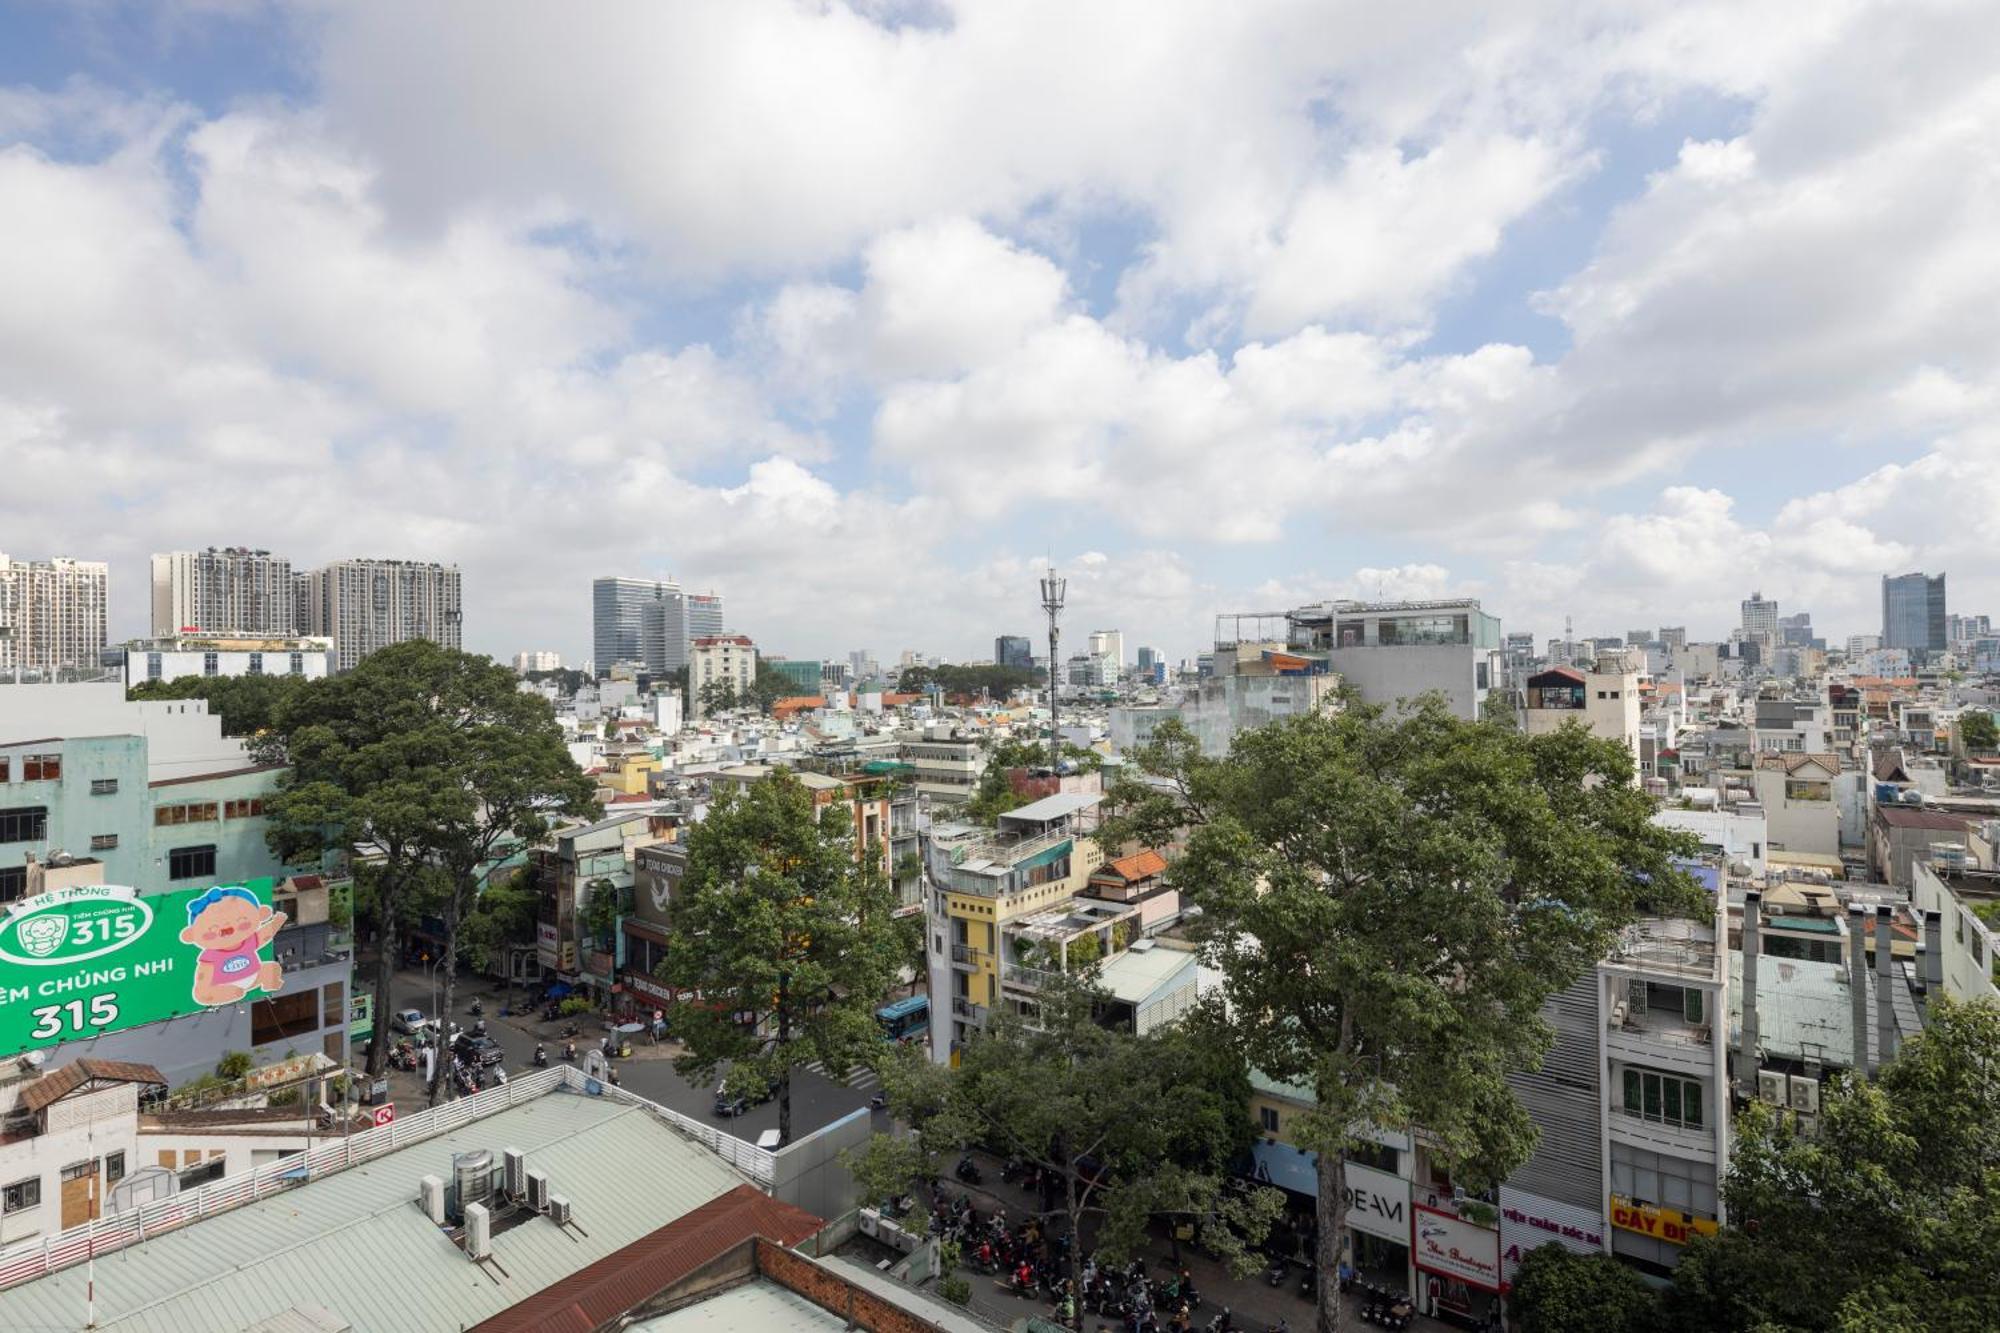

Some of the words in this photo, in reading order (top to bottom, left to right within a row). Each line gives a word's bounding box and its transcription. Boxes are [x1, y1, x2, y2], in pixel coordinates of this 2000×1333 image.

[71, 914, 135, 945] 315
[38, 967, 127, 996] CHỦNG
[134, 957, 174, 978] NHI
[31, 992, 119, 1039] 315
